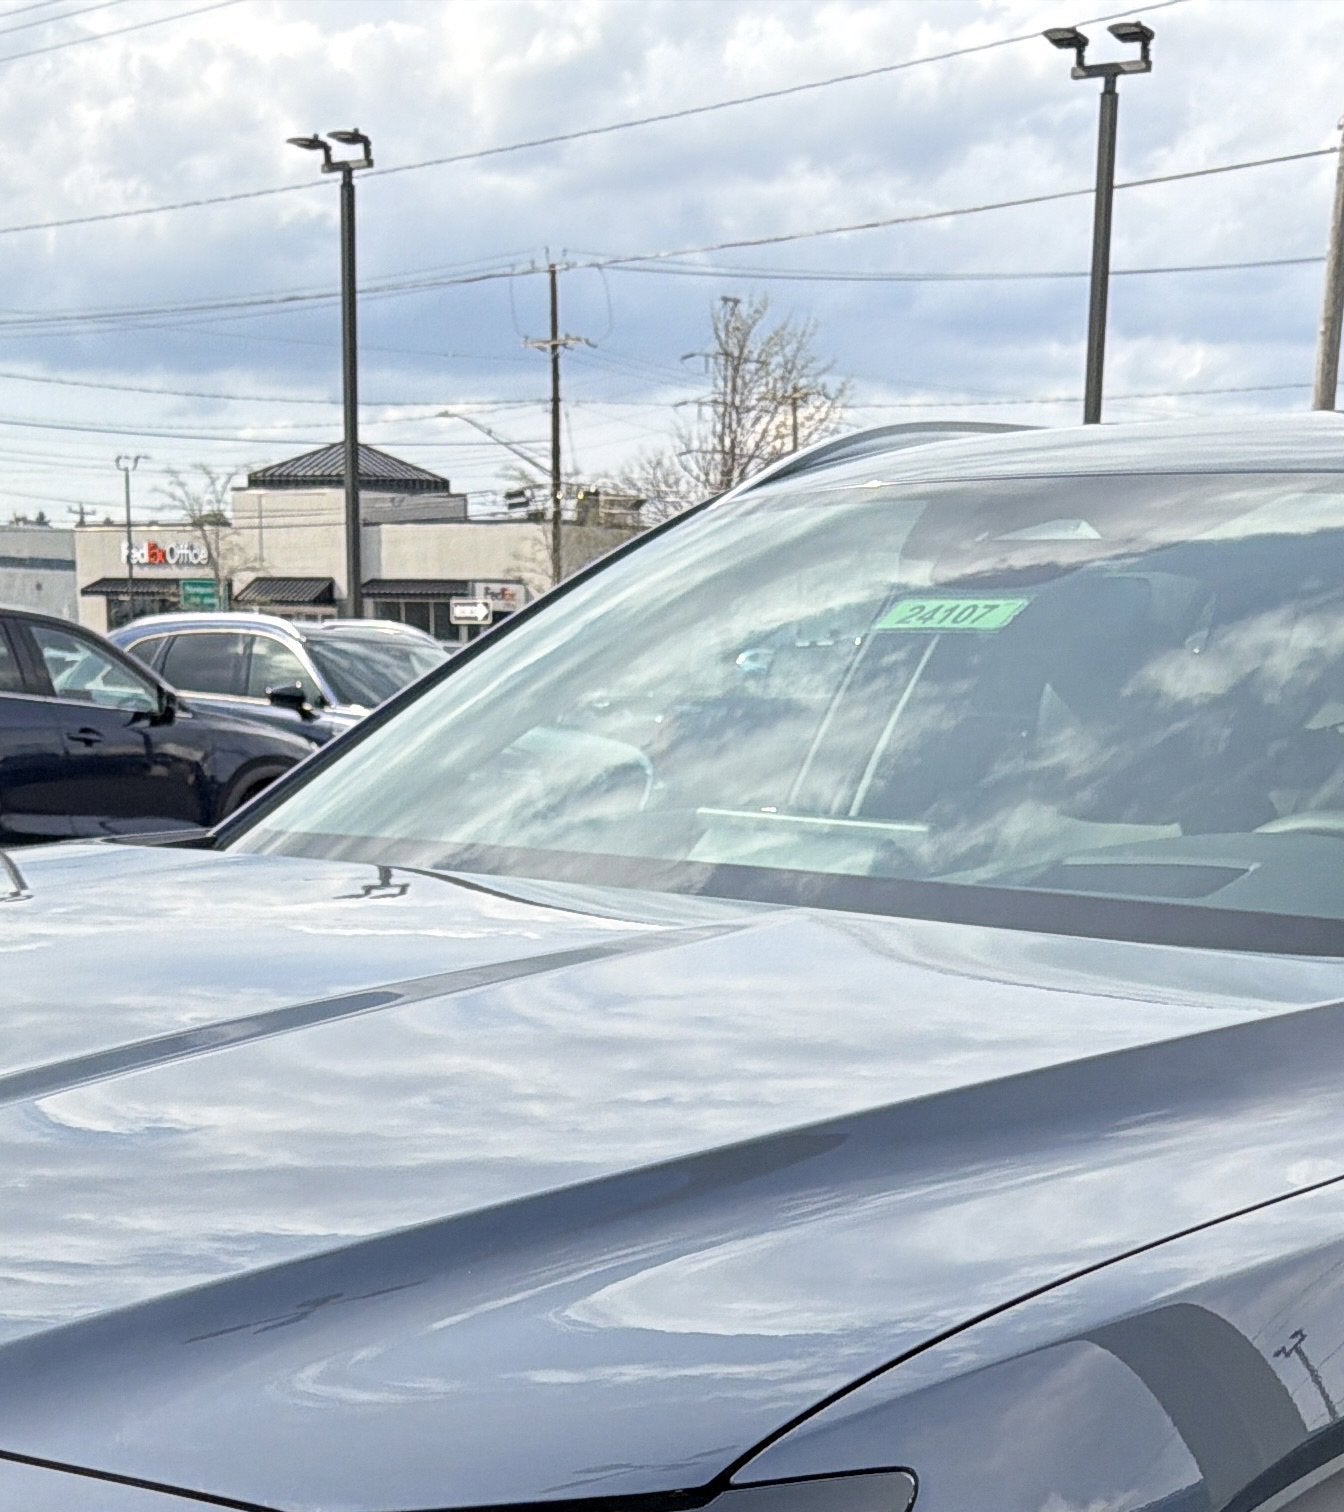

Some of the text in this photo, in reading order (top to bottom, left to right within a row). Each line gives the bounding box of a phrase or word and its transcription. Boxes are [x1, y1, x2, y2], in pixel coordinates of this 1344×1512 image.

[120, 539, 208, 565] FedEx Office
[895, 603, 1000, 626] 24107
